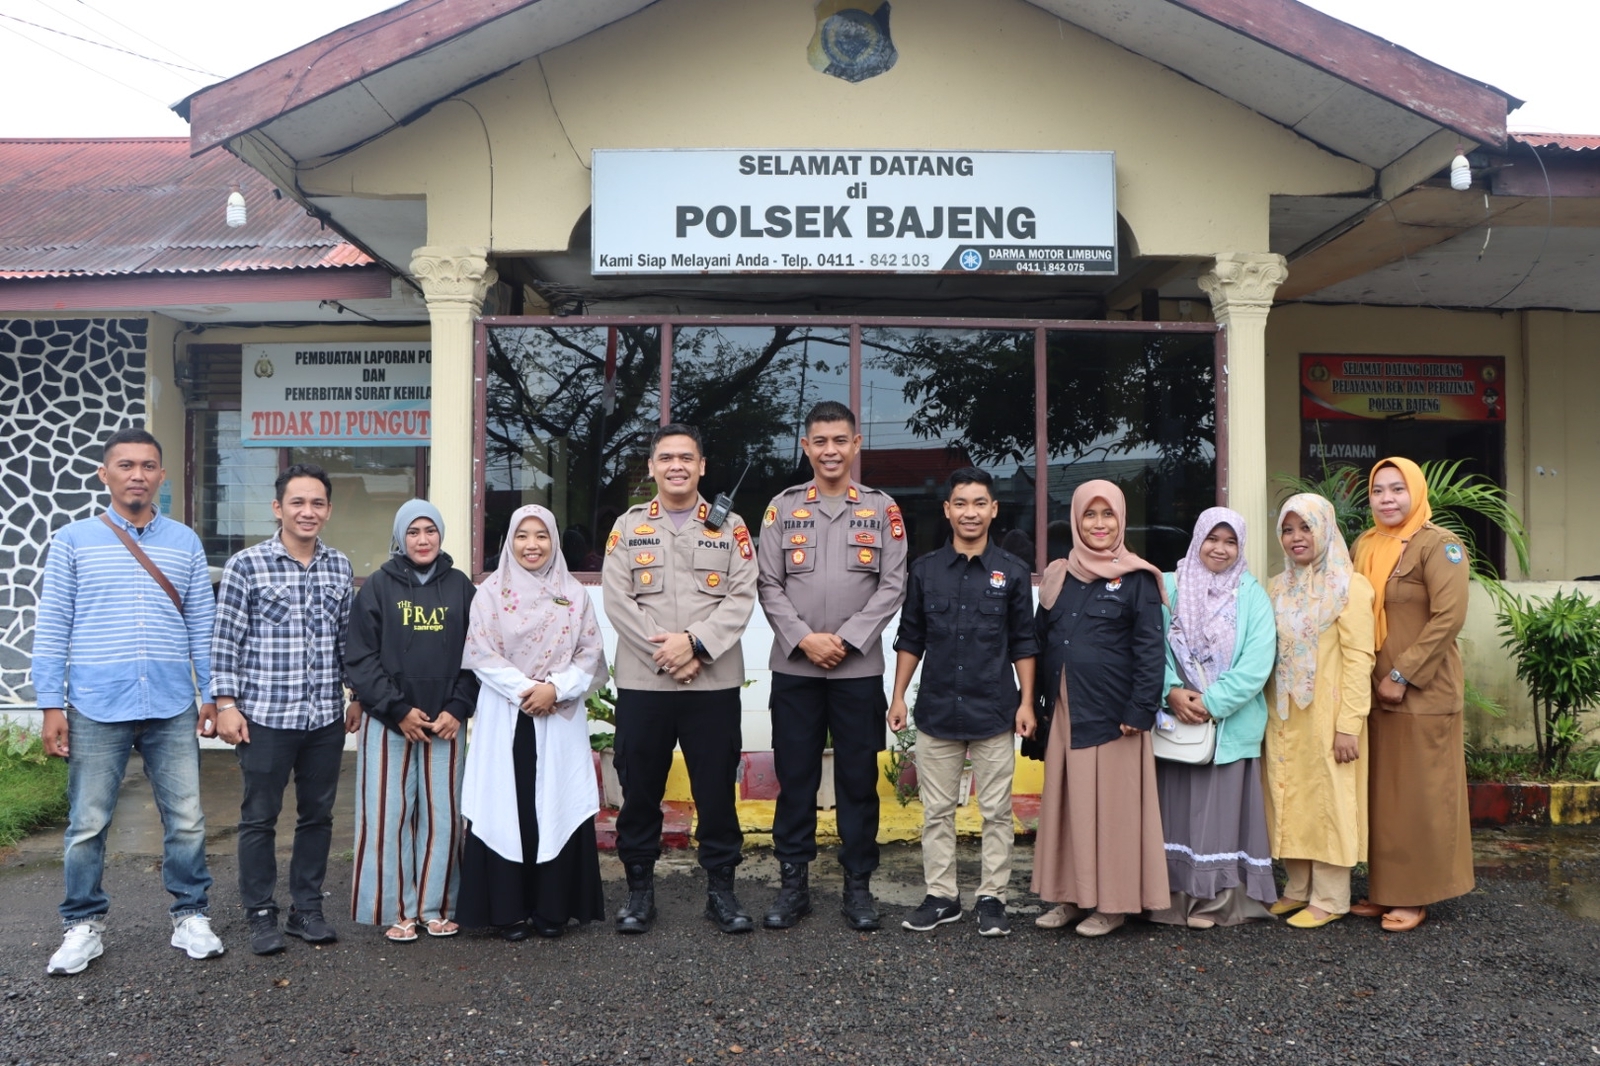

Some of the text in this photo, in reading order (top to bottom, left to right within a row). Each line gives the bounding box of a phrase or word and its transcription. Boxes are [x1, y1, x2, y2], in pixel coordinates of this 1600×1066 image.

[739, 155, 974, 177] SELAMAT DATANG
[846, 181, 868, 200] di
[676, 205, 1037, 240] POLSEK BAJENG
[600, 254, 632, 267] Kami
[637, 254, 667, 269] Siap
[671, 254, 731, 270] Melayani
[735, 254, 769, 267] Anda
[781, 254, 812, 269] Telp.
[817, 254, 855, 267] 0411
[870, 254, 898, 267] 842
[901, 254, 930, 267] 103
[988, 249, 1112, 260] DARMA MOTOR LIMBUNG
[1016, 262, 1041, 272] 0411
[1048, 262, 1066, 272] 842
[1067, 263, 1085, 272] 075
[295, 351, 361, 365] PEMBUATAN
[364, 350, 416, 364] LAPORAN
[362, 368, 386, 382] DAN
[1342, 361, 1463, 377] SELAMAT DATANG DIRUANG
[285, 387, 352, 401] PENERBITAN
[355, 387, 391, 400] SURAT
[1332, 379, 1383, 394] PELAYANAN
[1407, 380, 1425, 394] DAN
[1427, 380, 1475, 395] PERIZINAN
[1368, 397, 1440, 413] POLSEK BAJENG
[251, 410, 431, 436] TIDAK DI PUNGUT
[1309, 444, 1376, 458] PELAYANAN
[850, 520, 880, 529] POLRI
[629, 538, 660, 547] REONALD
[698, 540, 729, 549] POLRI
[397, 600, 412, 609] THE
[403, 606, 449, 625] PRAY
